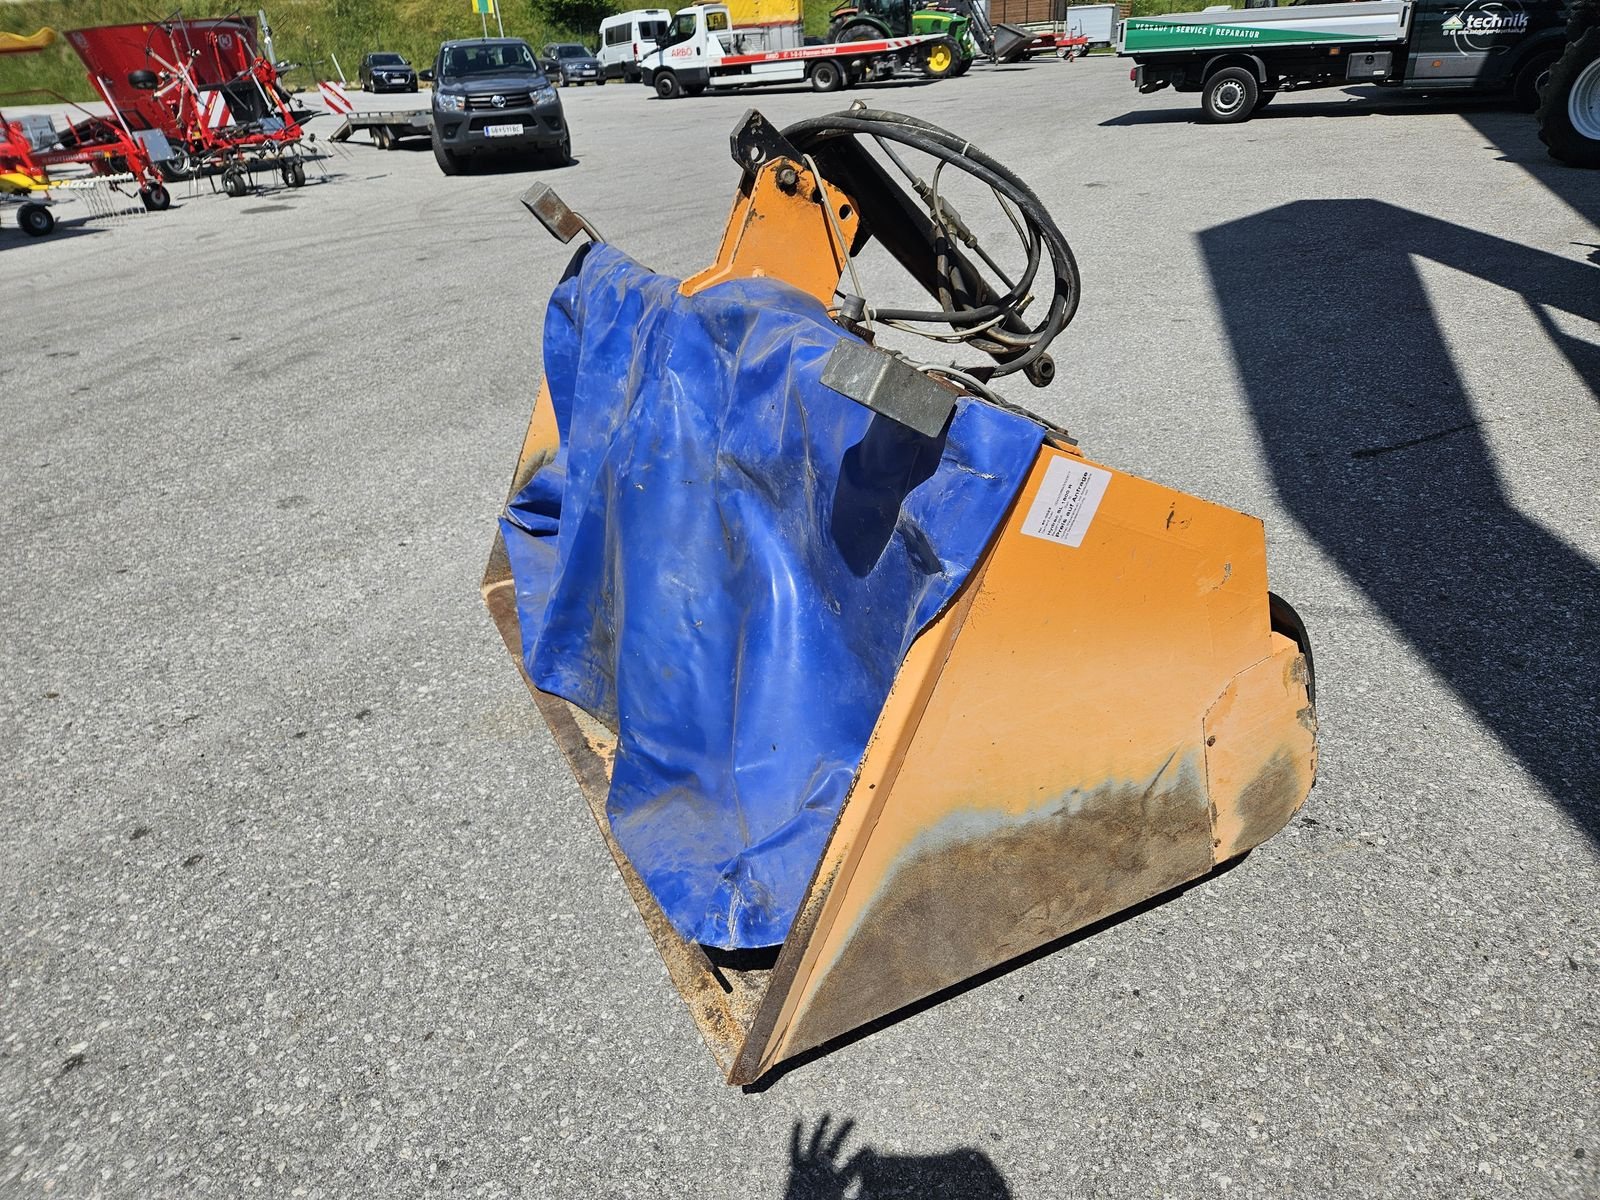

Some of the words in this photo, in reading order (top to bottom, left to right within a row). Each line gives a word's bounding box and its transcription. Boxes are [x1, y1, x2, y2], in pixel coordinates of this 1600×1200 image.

[1466, 13, 1529, 28] technik
[1175, 25, 1208, 35] SERVICE
[1215, 28, 1260, 38] REPARATUR
[1055, 518, 1067, 538] Preis
[1066, 503, 1074, 517] auf
[1072, 471, 1088, 503] Anfrage
